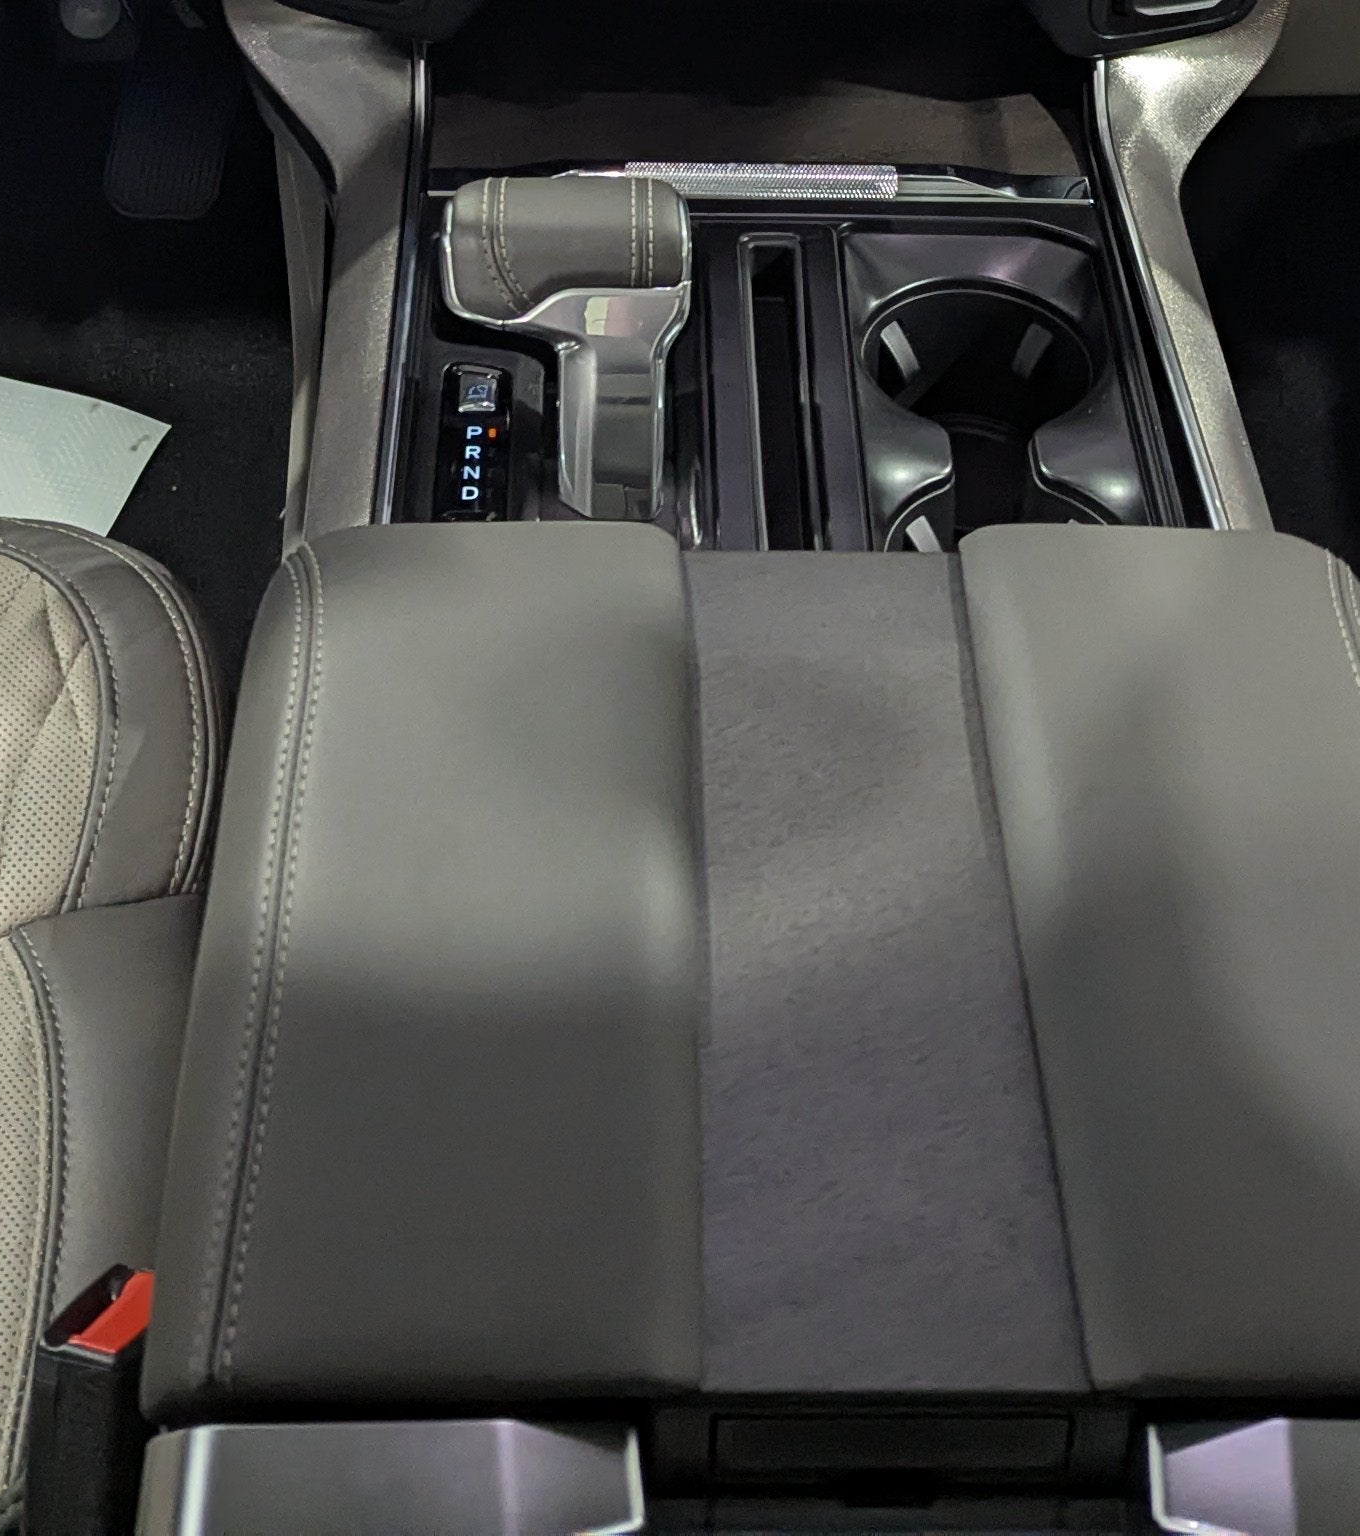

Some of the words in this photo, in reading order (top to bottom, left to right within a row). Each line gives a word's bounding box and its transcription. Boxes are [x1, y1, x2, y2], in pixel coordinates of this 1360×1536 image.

[466, 426, 482, 439] P
[464, 445, 481, 459] R
[463, 466, 480, 480] N
[461, 486, 479, 500] D
